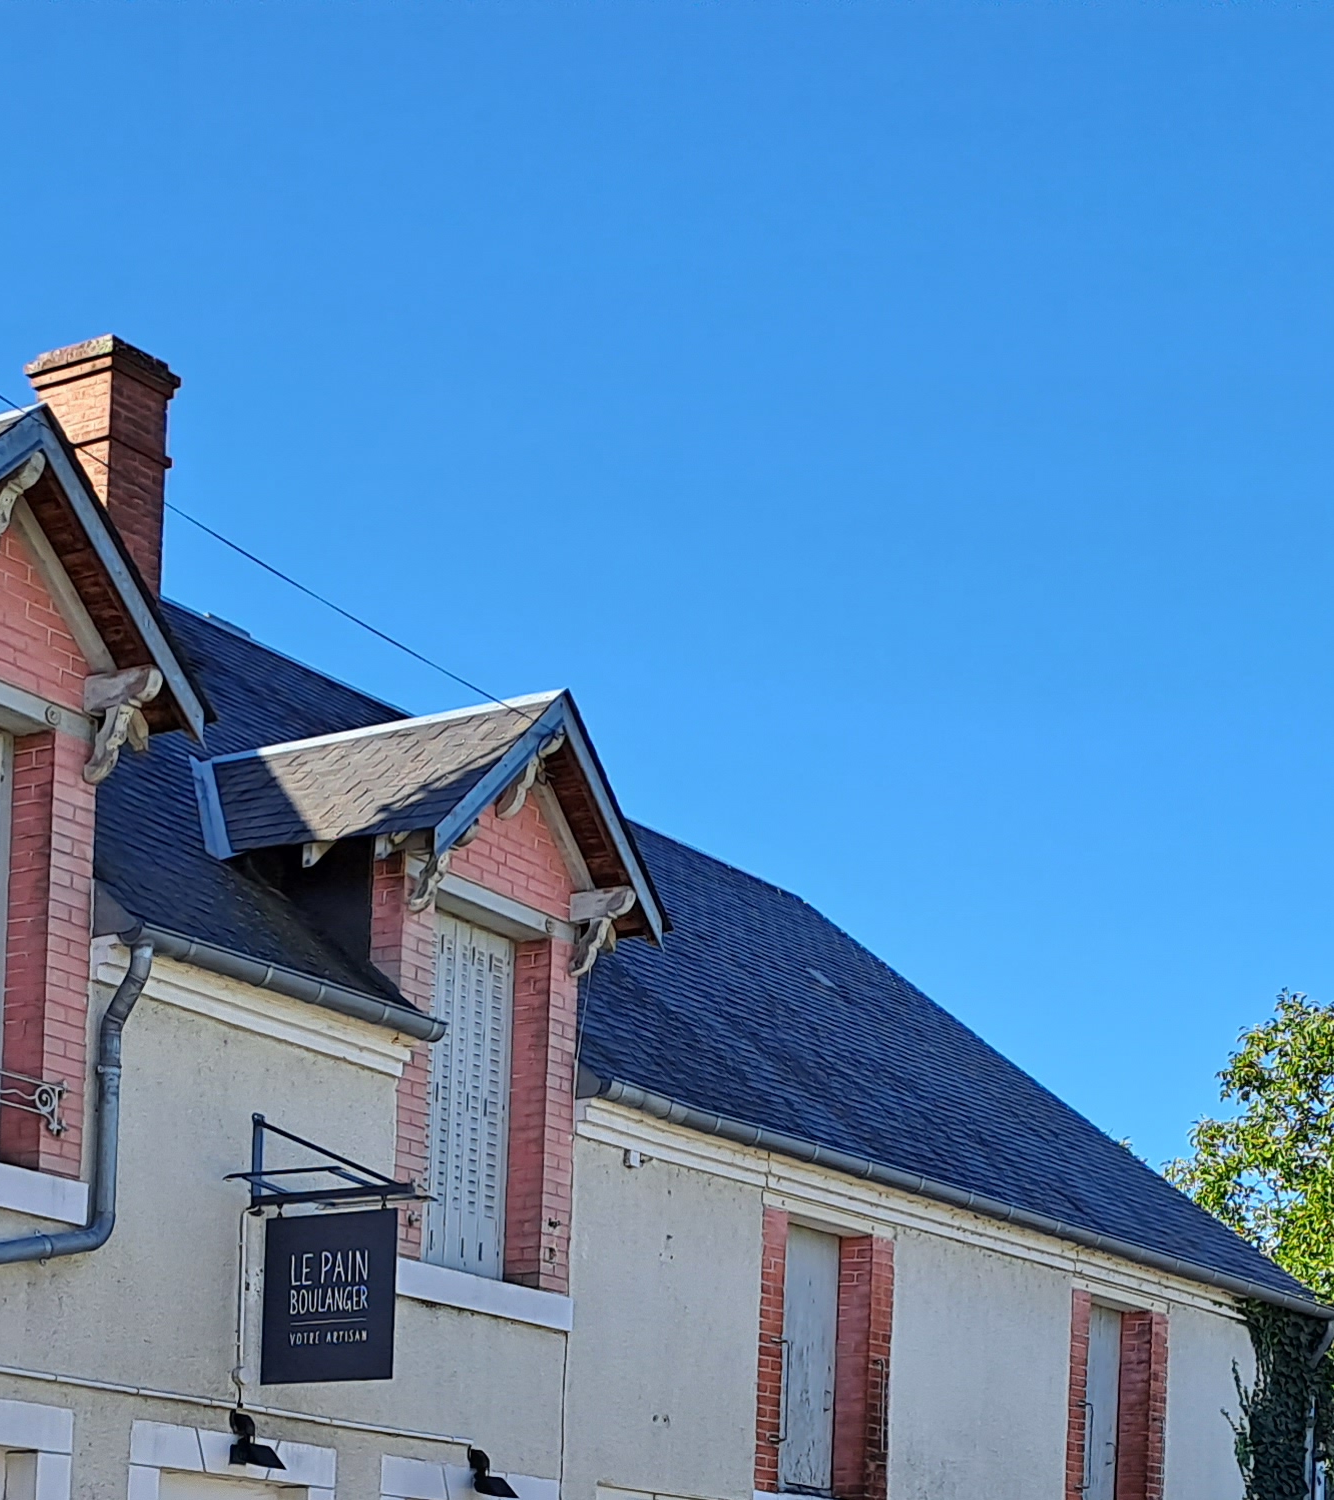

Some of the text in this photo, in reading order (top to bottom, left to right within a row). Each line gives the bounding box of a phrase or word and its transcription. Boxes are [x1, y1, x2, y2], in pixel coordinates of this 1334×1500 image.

[291, 1250, 368, 1285] LE PAIN
[290, 1286, 368, 1314] BOULANGER
[290, 1330, 367, 1346] VOTRE ARTISAN
